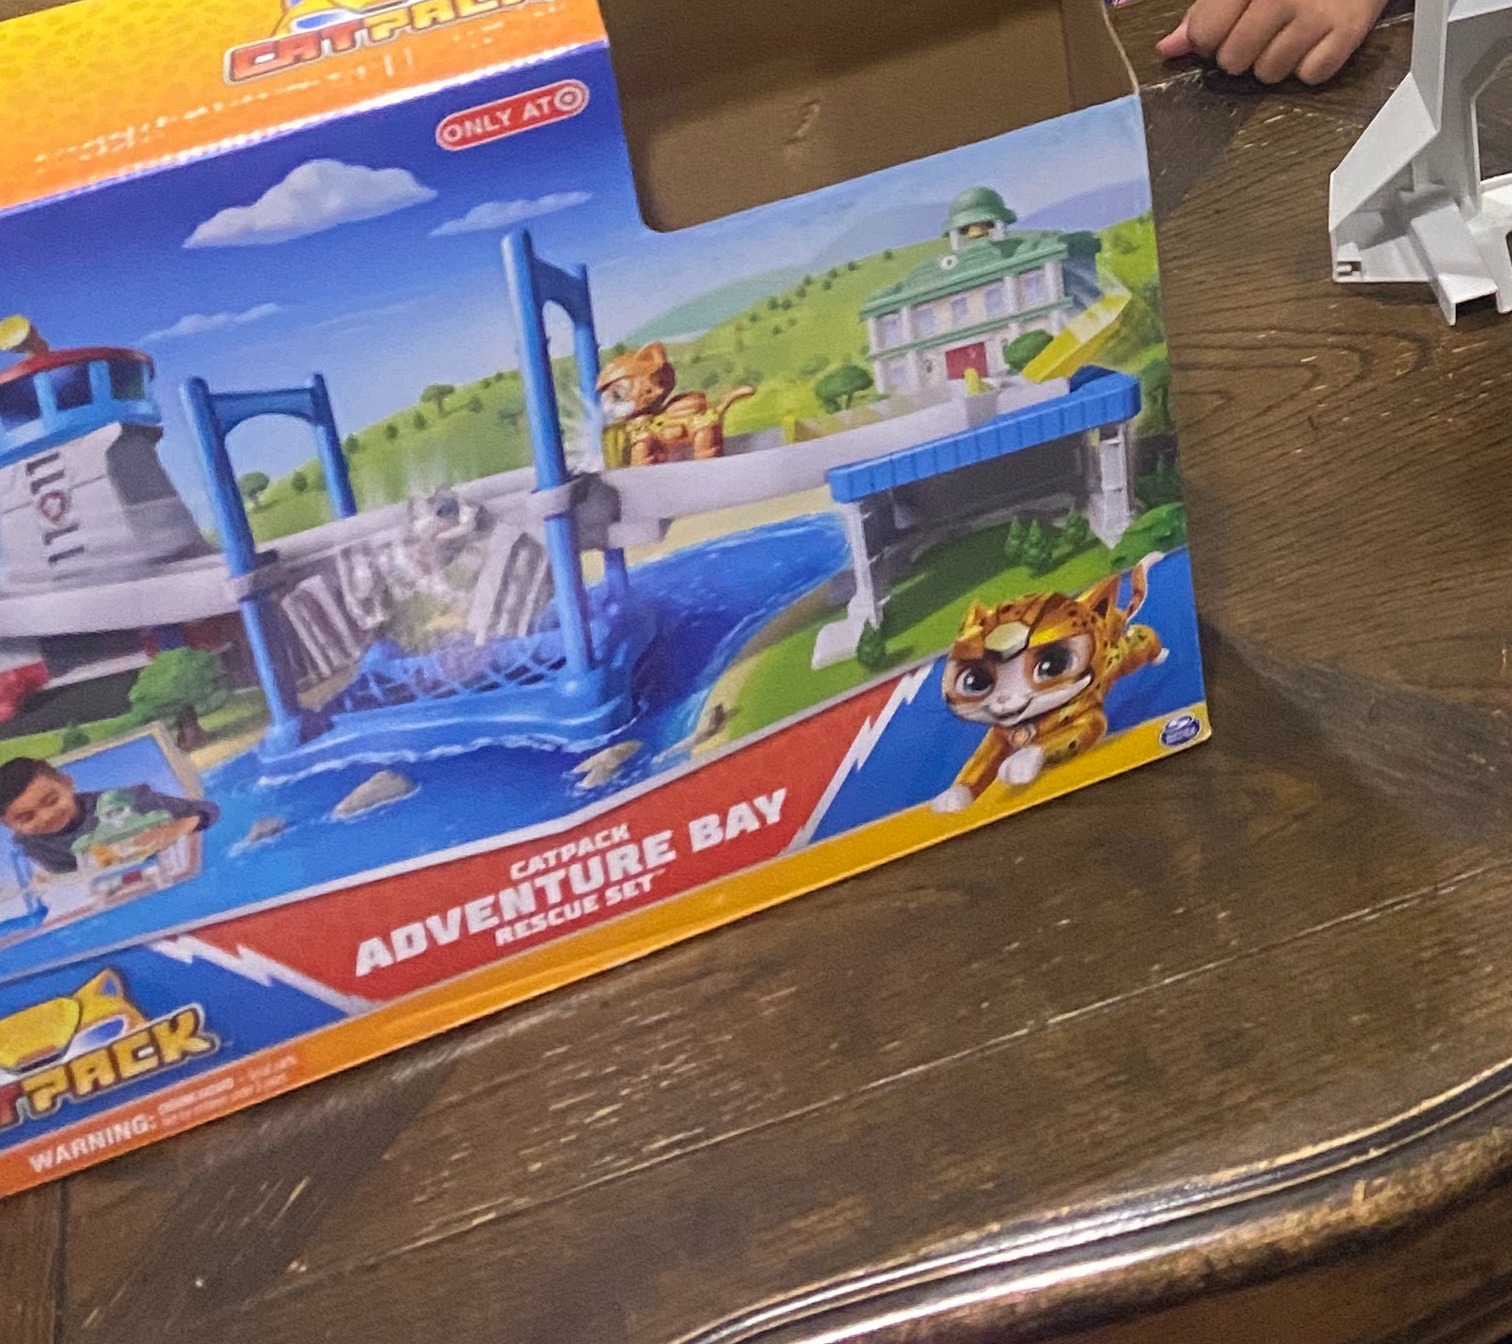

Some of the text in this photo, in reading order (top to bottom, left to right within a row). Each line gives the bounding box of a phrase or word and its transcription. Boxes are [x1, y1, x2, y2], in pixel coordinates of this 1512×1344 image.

[444, 97, 551, 144] ONLY AT
[355, 787, 788, 977] ADVENTURE BAY
[510, 822, 630, 881] CATPACK
[494, 873, 656, 946] RESCUE SET
[28, 1113, 157, 1174] WARNING:
